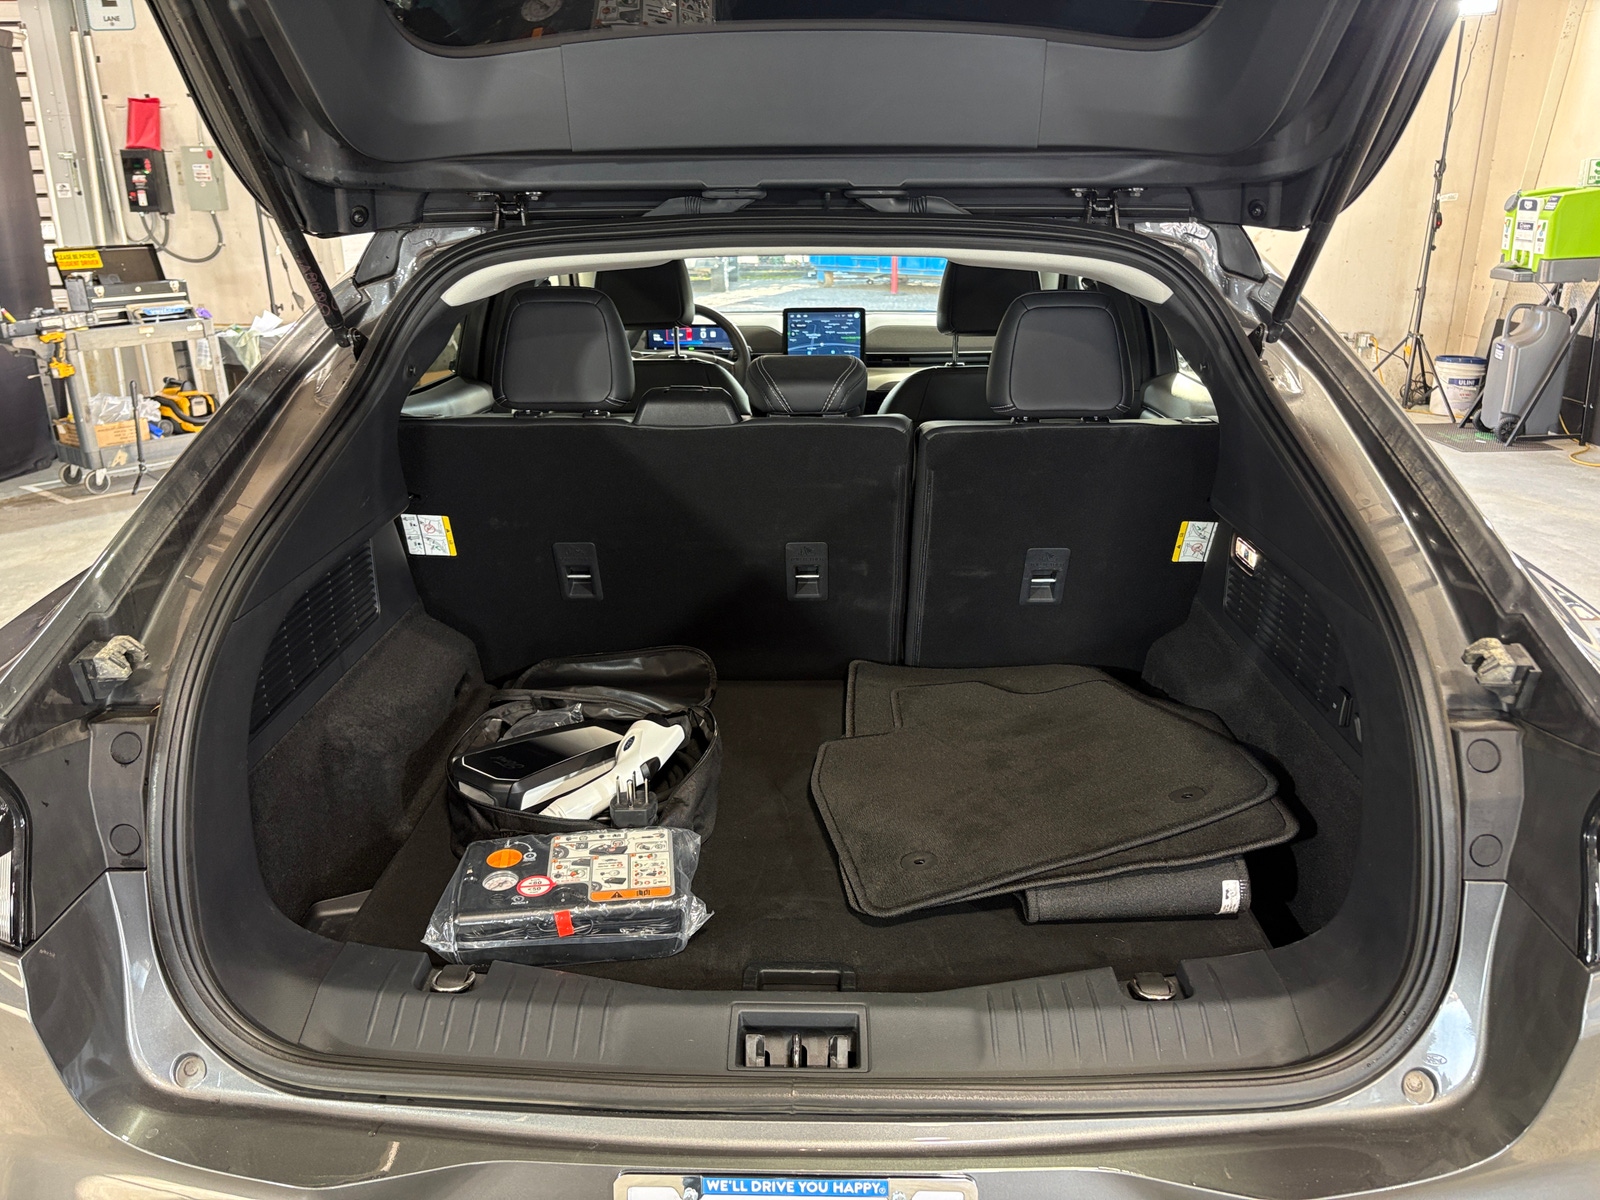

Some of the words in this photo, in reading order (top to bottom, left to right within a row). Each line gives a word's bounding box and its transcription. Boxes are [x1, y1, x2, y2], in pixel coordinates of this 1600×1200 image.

[706, 1179, 748, 1193] WE'LL
[751, 1180, 795, 1193] DRIVE
[798, 1181, 829, 1193] YOU
